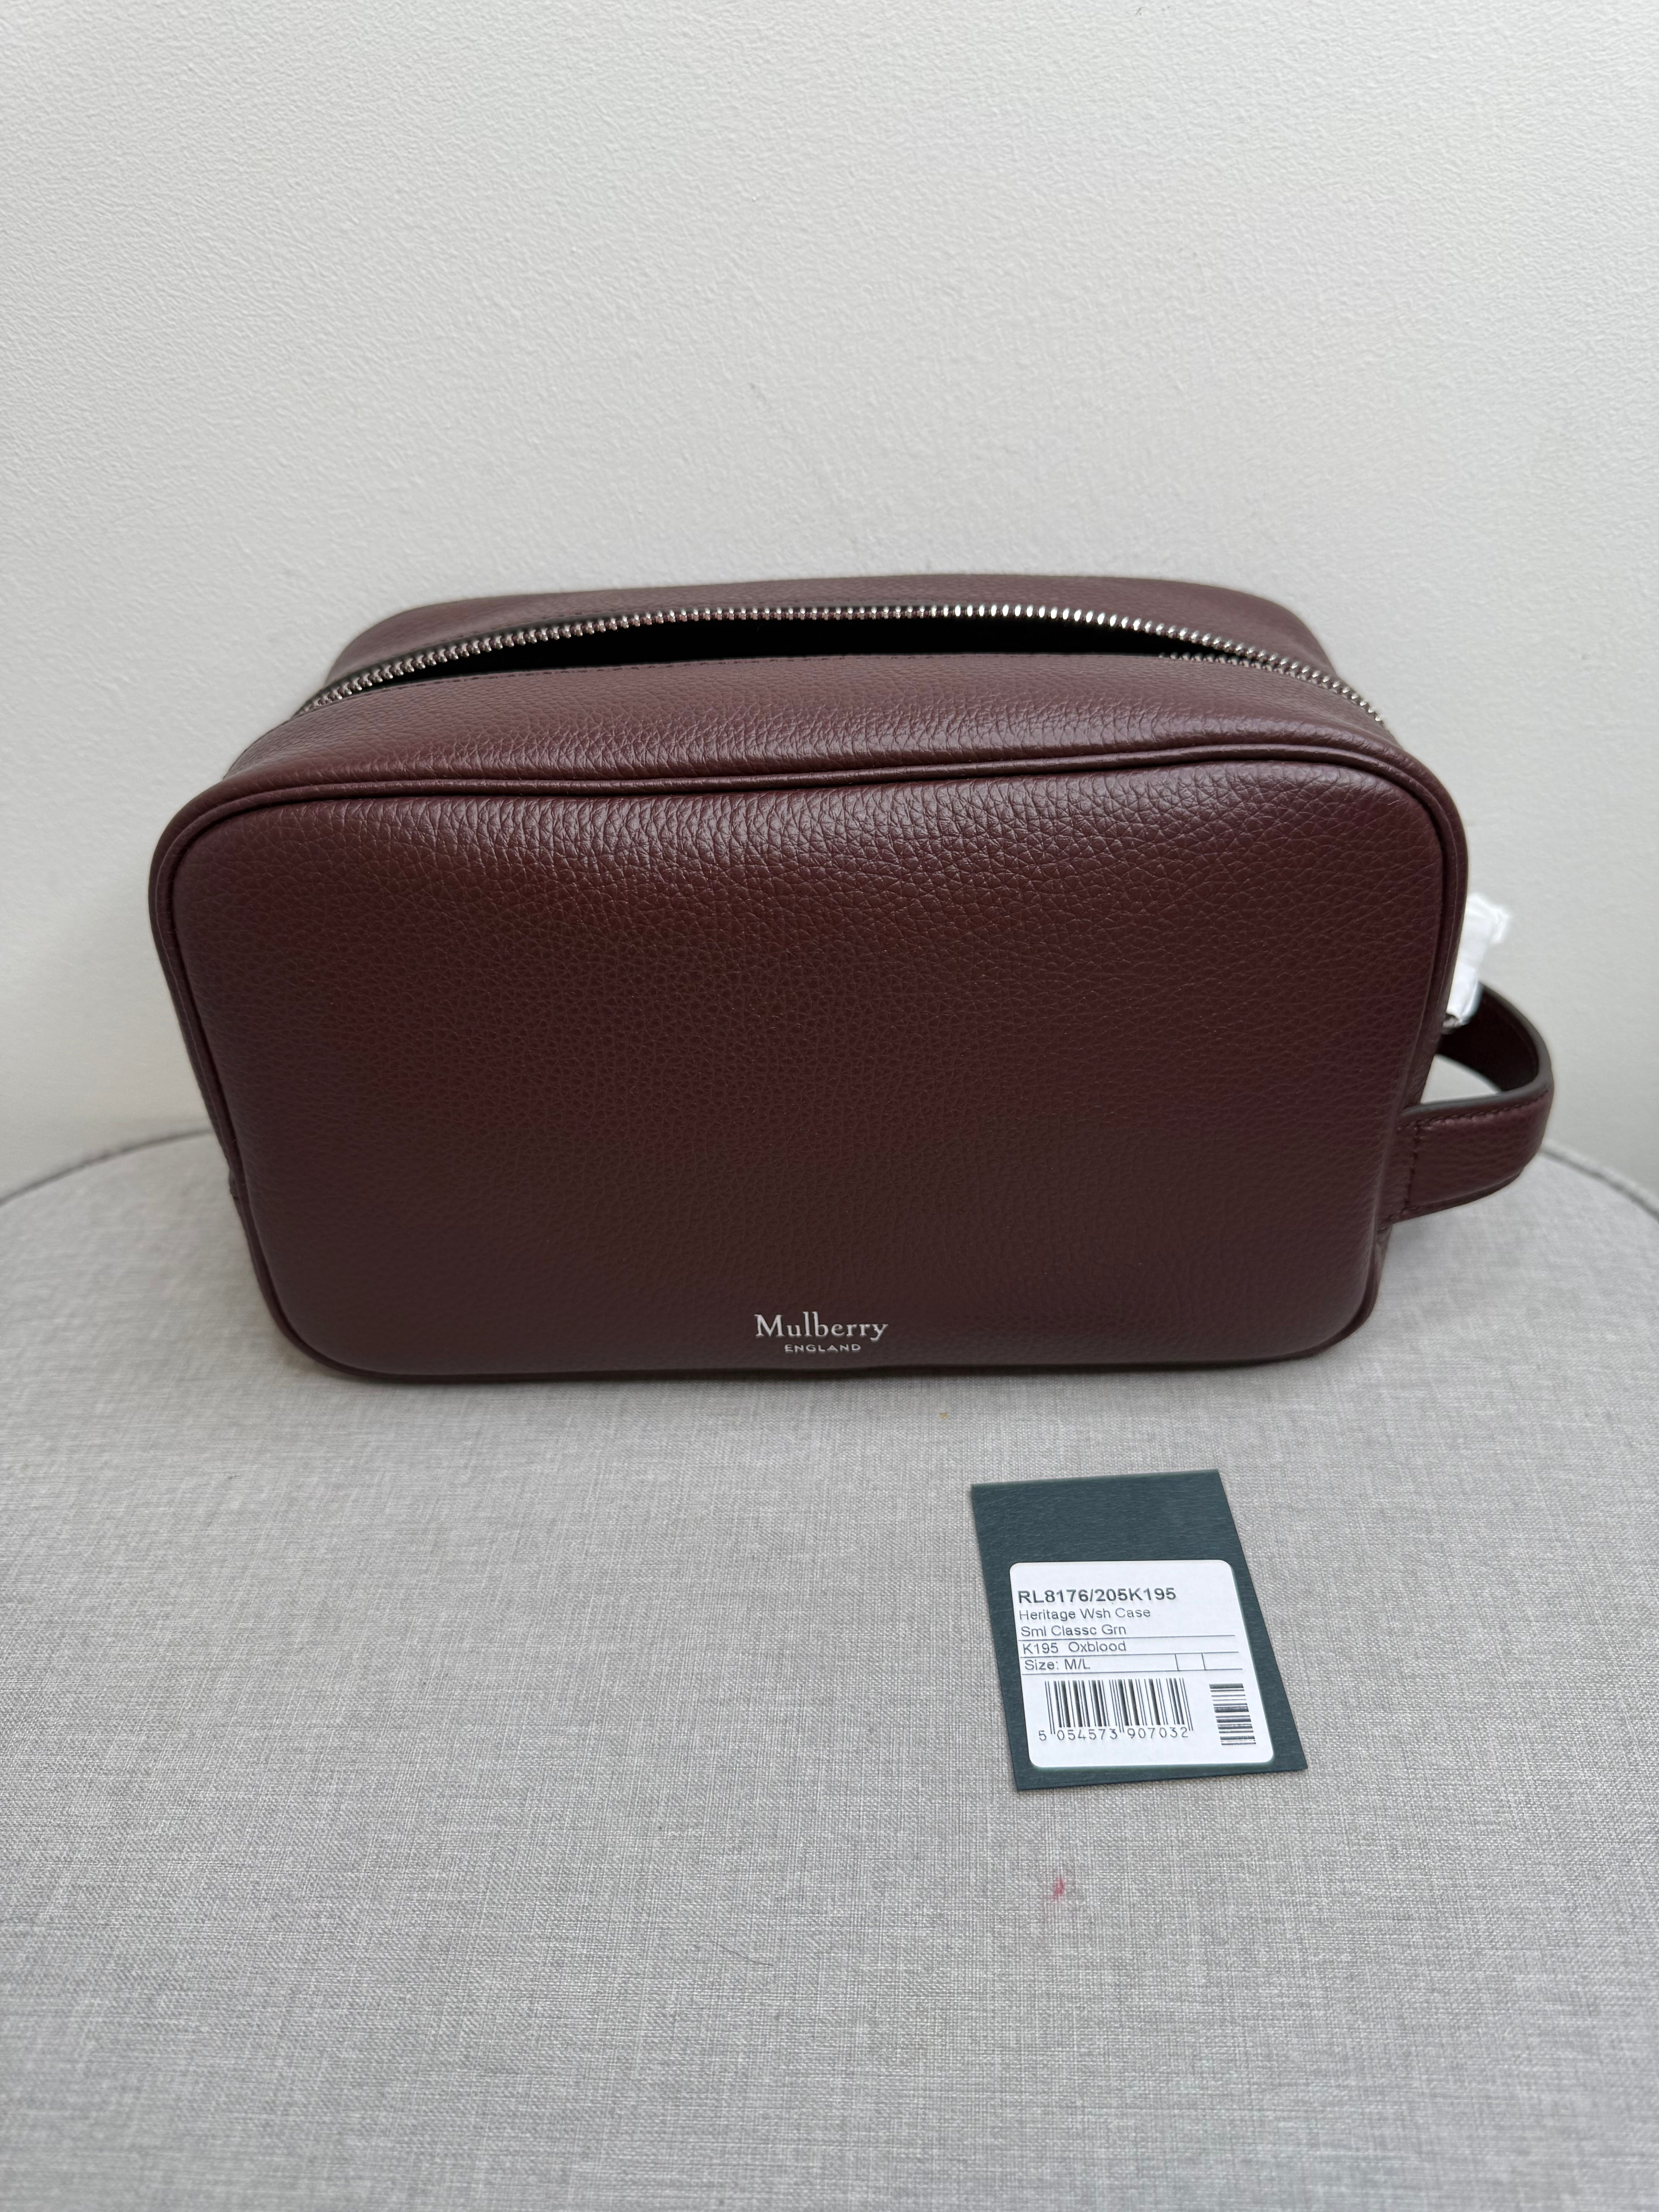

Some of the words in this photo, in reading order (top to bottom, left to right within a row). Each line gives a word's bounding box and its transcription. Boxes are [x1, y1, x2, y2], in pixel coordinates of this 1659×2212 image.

[754, 1311, 889, 1342] Mulberry
[784, 1344, 861, 1353] ENGLAND
[1018, 1587, 1176, 1603] RL8176/205K195
[1019, 1609, 1076, 1621] Heritage
[1080, 1608, 1111, 1619] Wsh
[1115, 1607, 1151, 1618] Case
[1021, 1626, 1046, 1637] Sml
[1051, 1625, 1097, 1636] Classc
[1102, 1624, 1126, 1634] Grn
[1023, 1642, 1058, 1654] K195
[1068, 1640, 1126, 1653] Oxblood
[1025, 1659, 1059, 1670] Size:
[1065, 1659, 1090, 1670] M/L
[1039, 1730, 1047, 1741] 5
[1057, 1728, 1118, 1741] 054573
[1127, 1726, 1189, 1739] 907032
